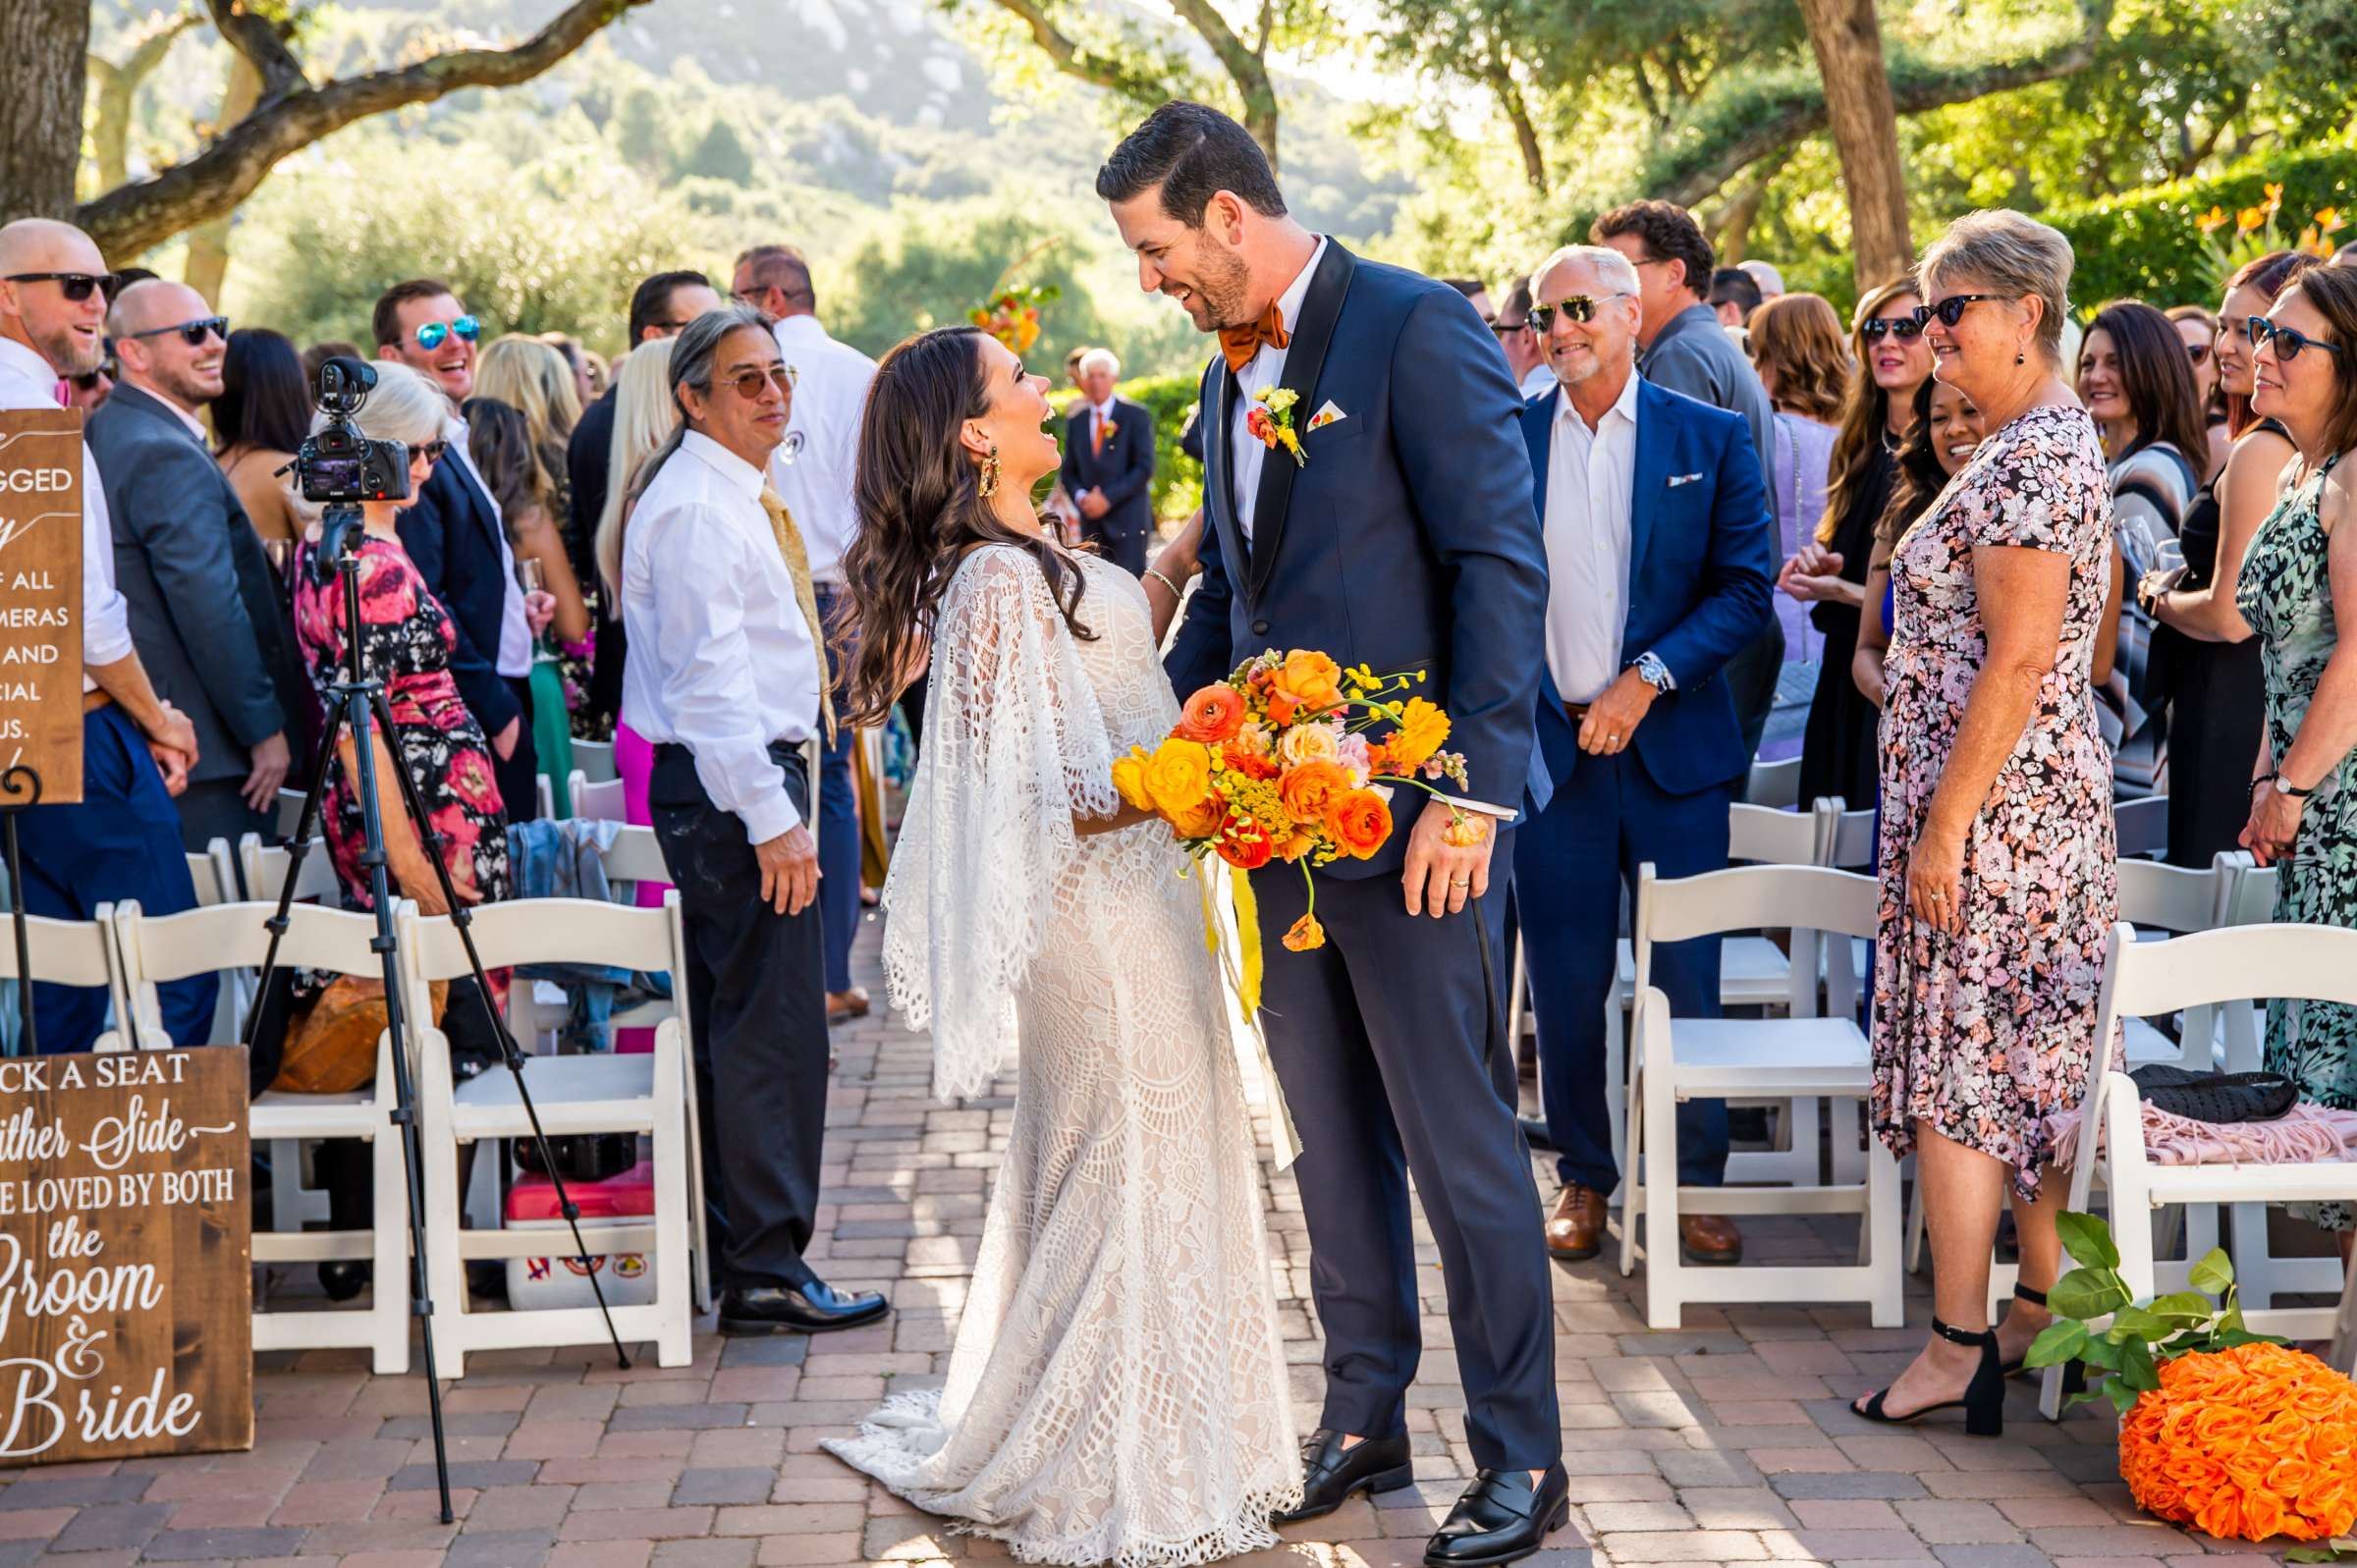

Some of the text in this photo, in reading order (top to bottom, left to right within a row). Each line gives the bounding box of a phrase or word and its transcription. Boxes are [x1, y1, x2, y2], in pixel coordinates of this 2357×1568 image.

[12, 571, 55, 590] ALL
[2, 644, 60, 665] AND
[0, 681, 41, 701] IAL
[59, 1059, 86, 1090] A
[95, 1054, 190, 1087] SEAT
[79, 1094, 188, 1170] Side
[22, 1175, 113, 1214] LOVED
[118, 1172, 155, 1207] BY
[162, 1168, 234, 1205] BOTH
[48, 1215, 105, 1259] the
[55, 1315, 108, 1380] &
[0, 1357, 202, 1457] Bride
